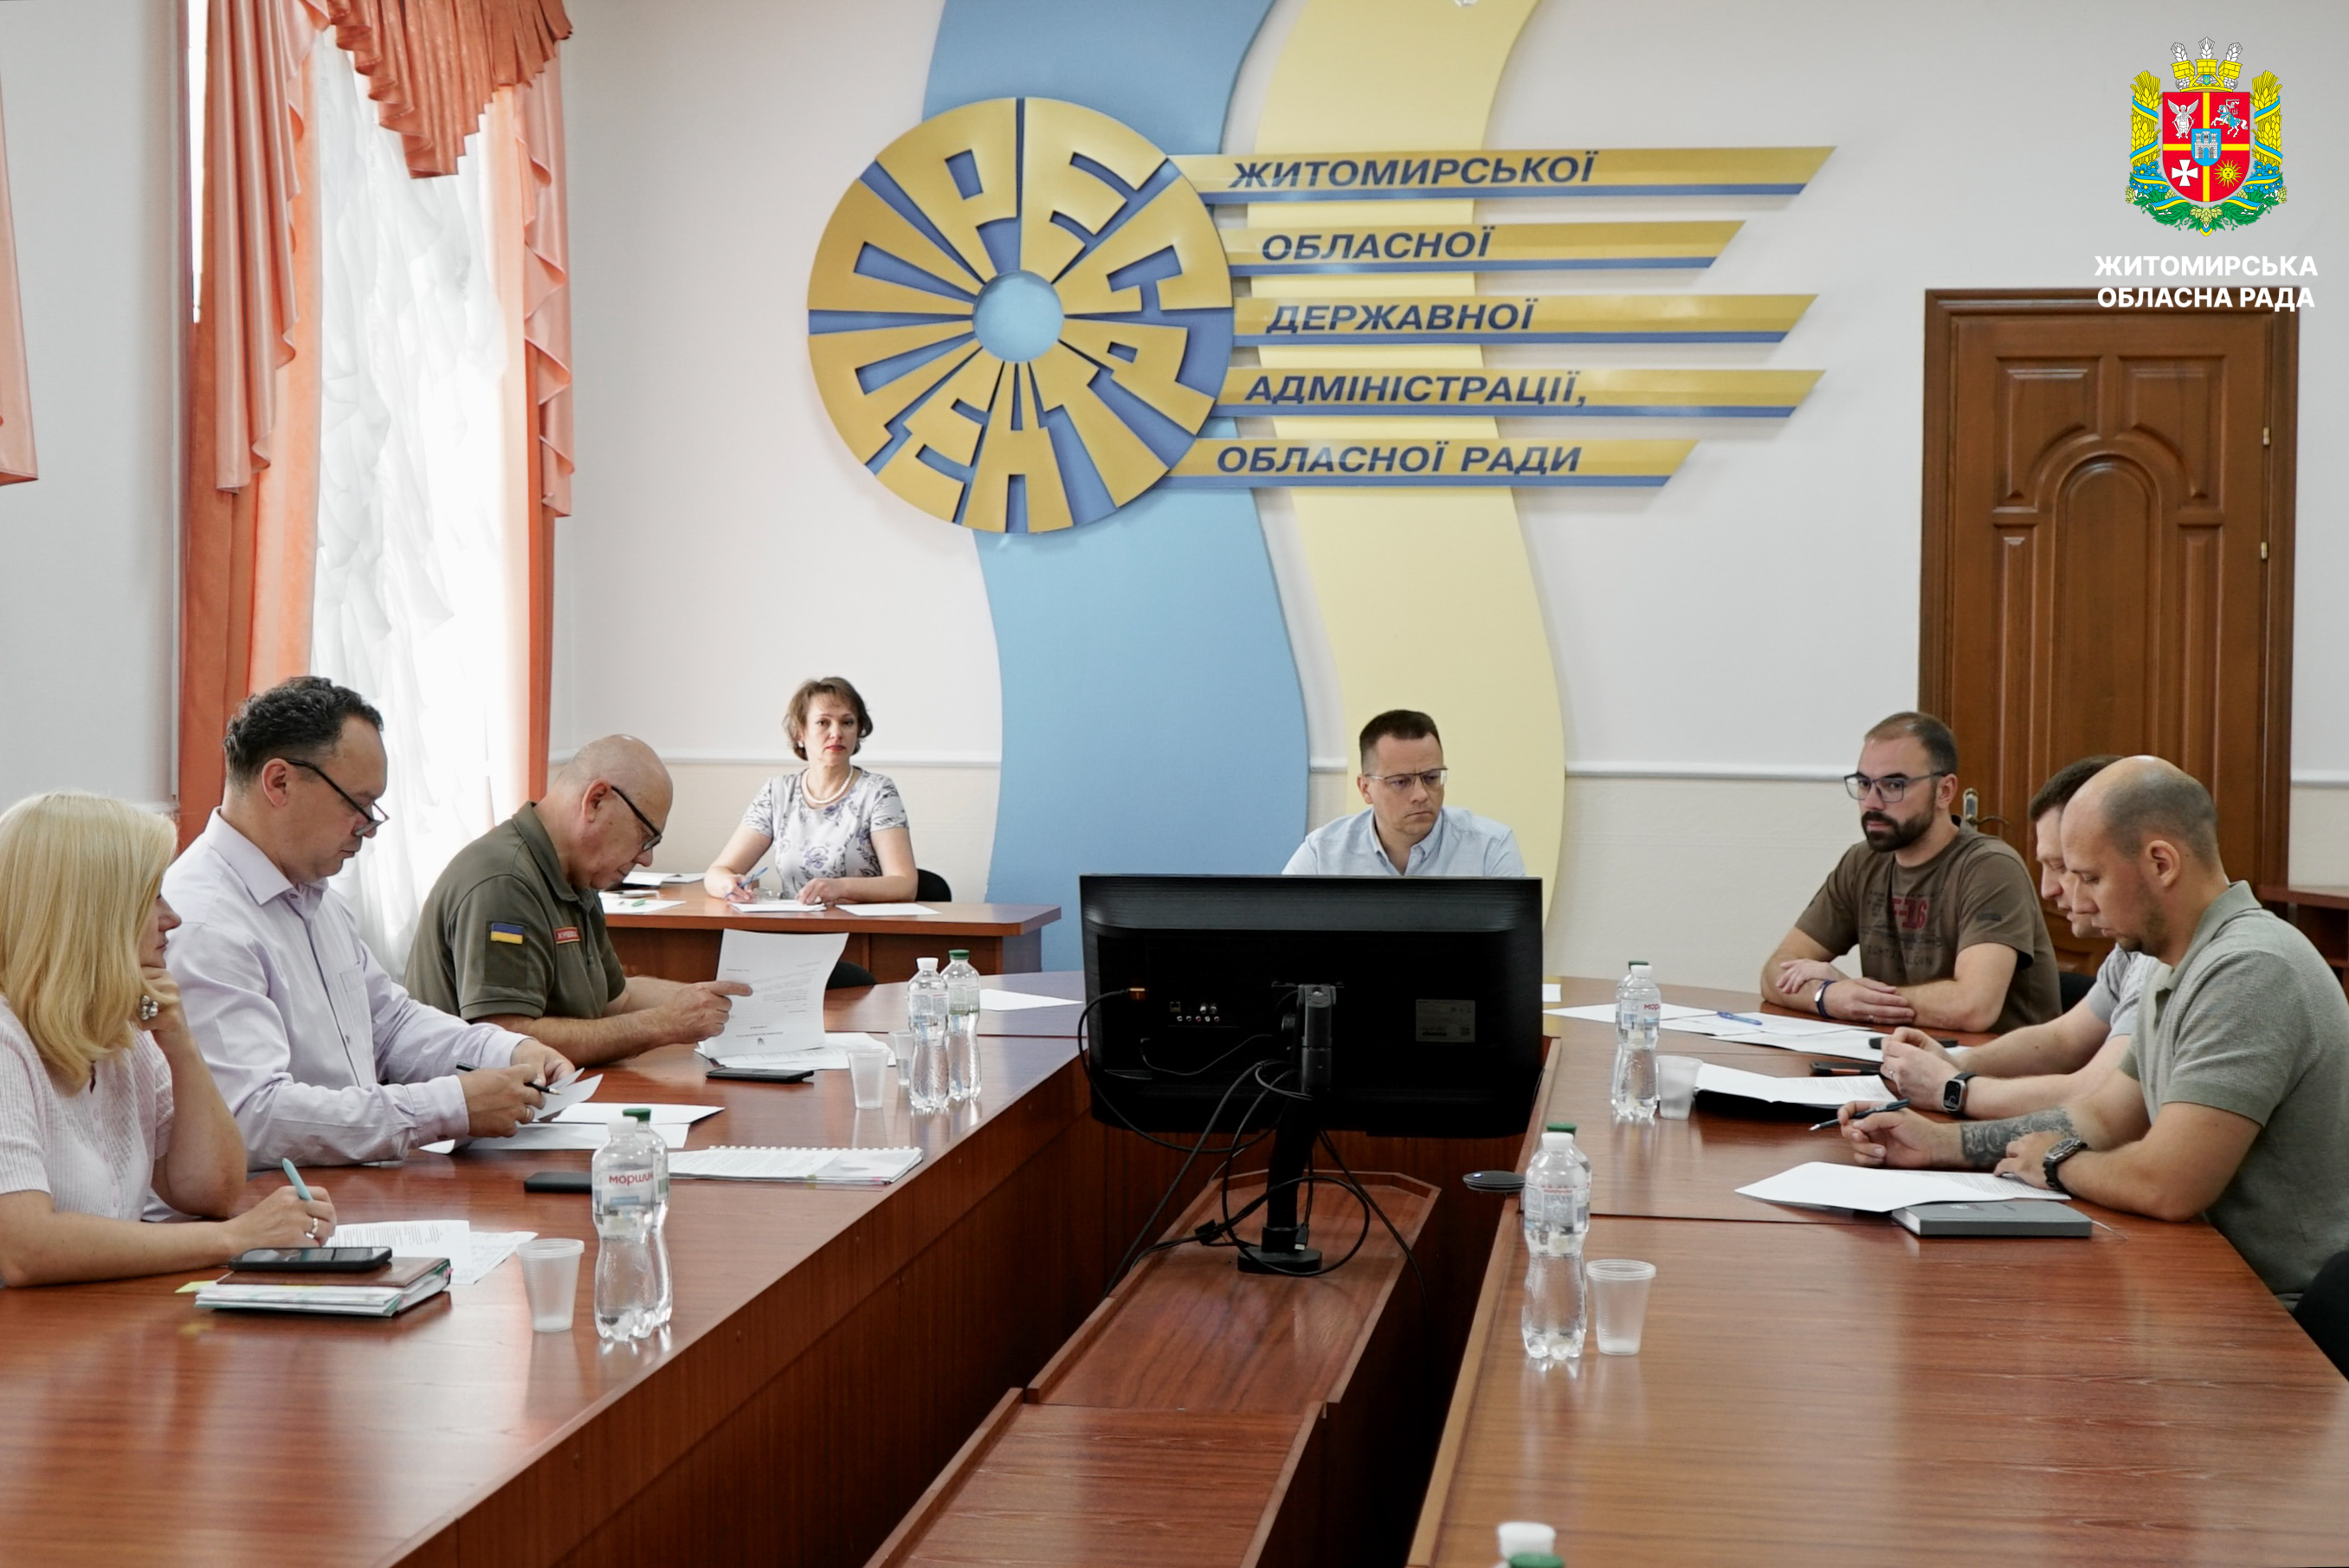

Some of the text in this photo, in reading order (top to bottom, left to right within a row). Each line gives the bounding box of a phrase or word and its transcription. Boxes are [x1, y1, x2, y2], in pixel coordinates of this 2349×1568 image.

[1229, 151, 1599, 189] ЖИТОМИРСЬКОЇ
[1262, 225, 1495, 260] ОБЛАСНОЇ
[1265, 298, 1540, 334] ДЕРЖАВНОЇ
[1244, 371, 1587, 407] АДМІНІСТРАЦІЇ,
[1216, 441, 1583, 475] ОБЛАСНОЇ РАДИ
